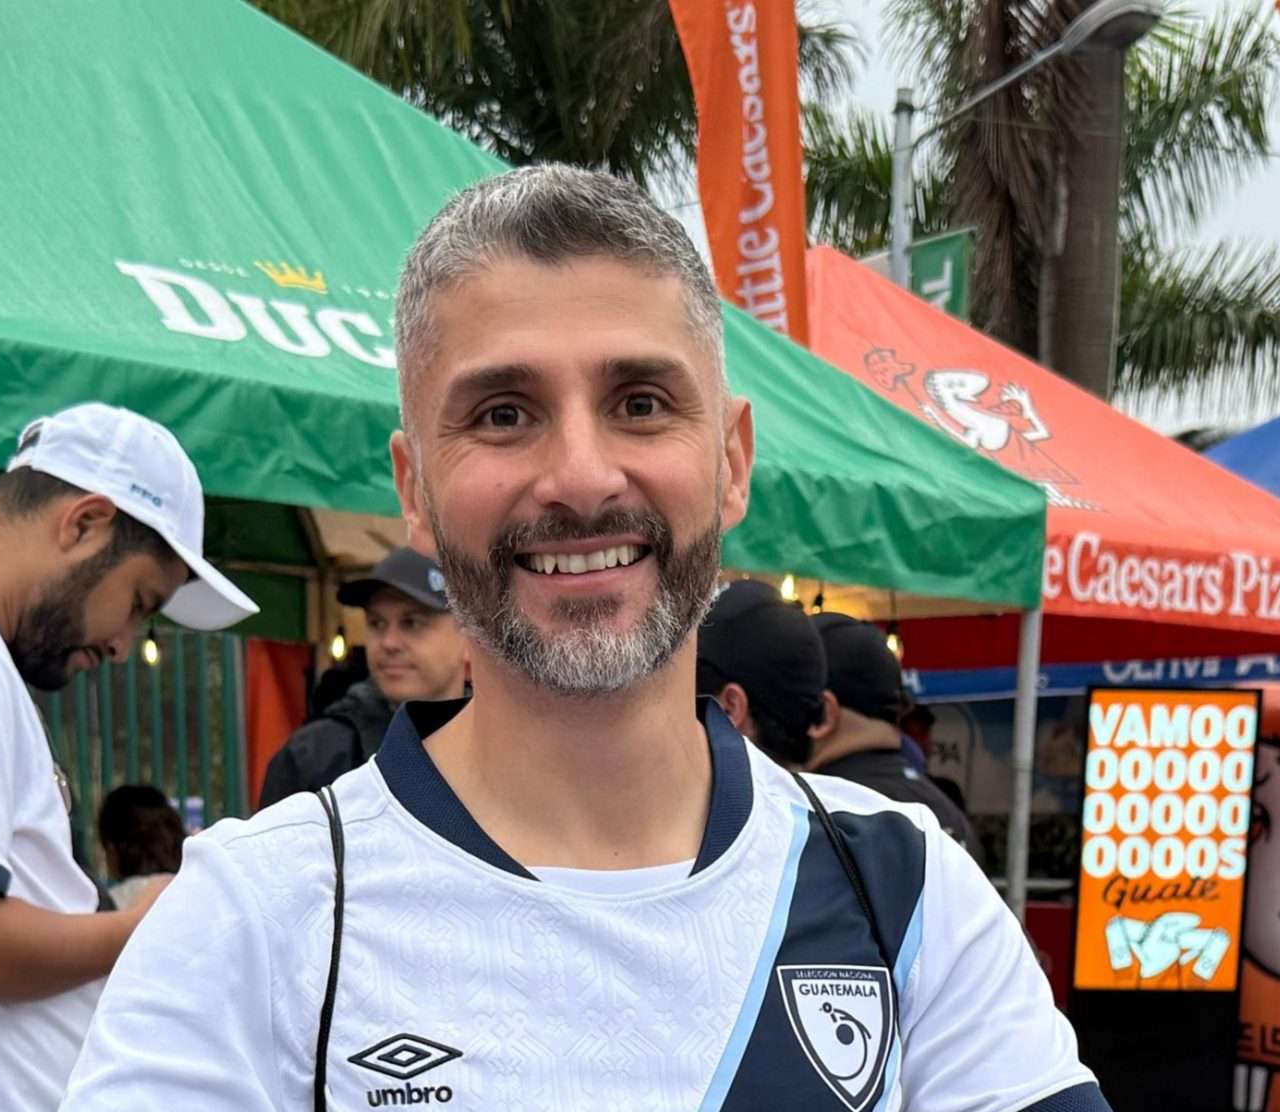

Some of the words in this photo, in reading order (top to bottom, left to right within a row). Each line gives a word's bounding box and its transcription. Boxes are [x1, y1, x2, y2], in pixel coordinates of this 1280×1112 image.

[725, 2, 775, 225] Caesars
[735, 226, 790, 337] ittle
[113, 259, 399, 370] DUC
[1067, 531, 1223, 616] Caesars
[1088, 702, 1259, 750] VAMOO
[1085, 747, 1255, 793] OOOOO
[1082, 791, 1252, 836] OOOOO
[1081, 834, 1247, 880] OOOOS
[1102, 875, 1220, 909] Guate
[798, 983, 878, 998] GUATEMALA
[367, 1082, 453, 1108] umbro
